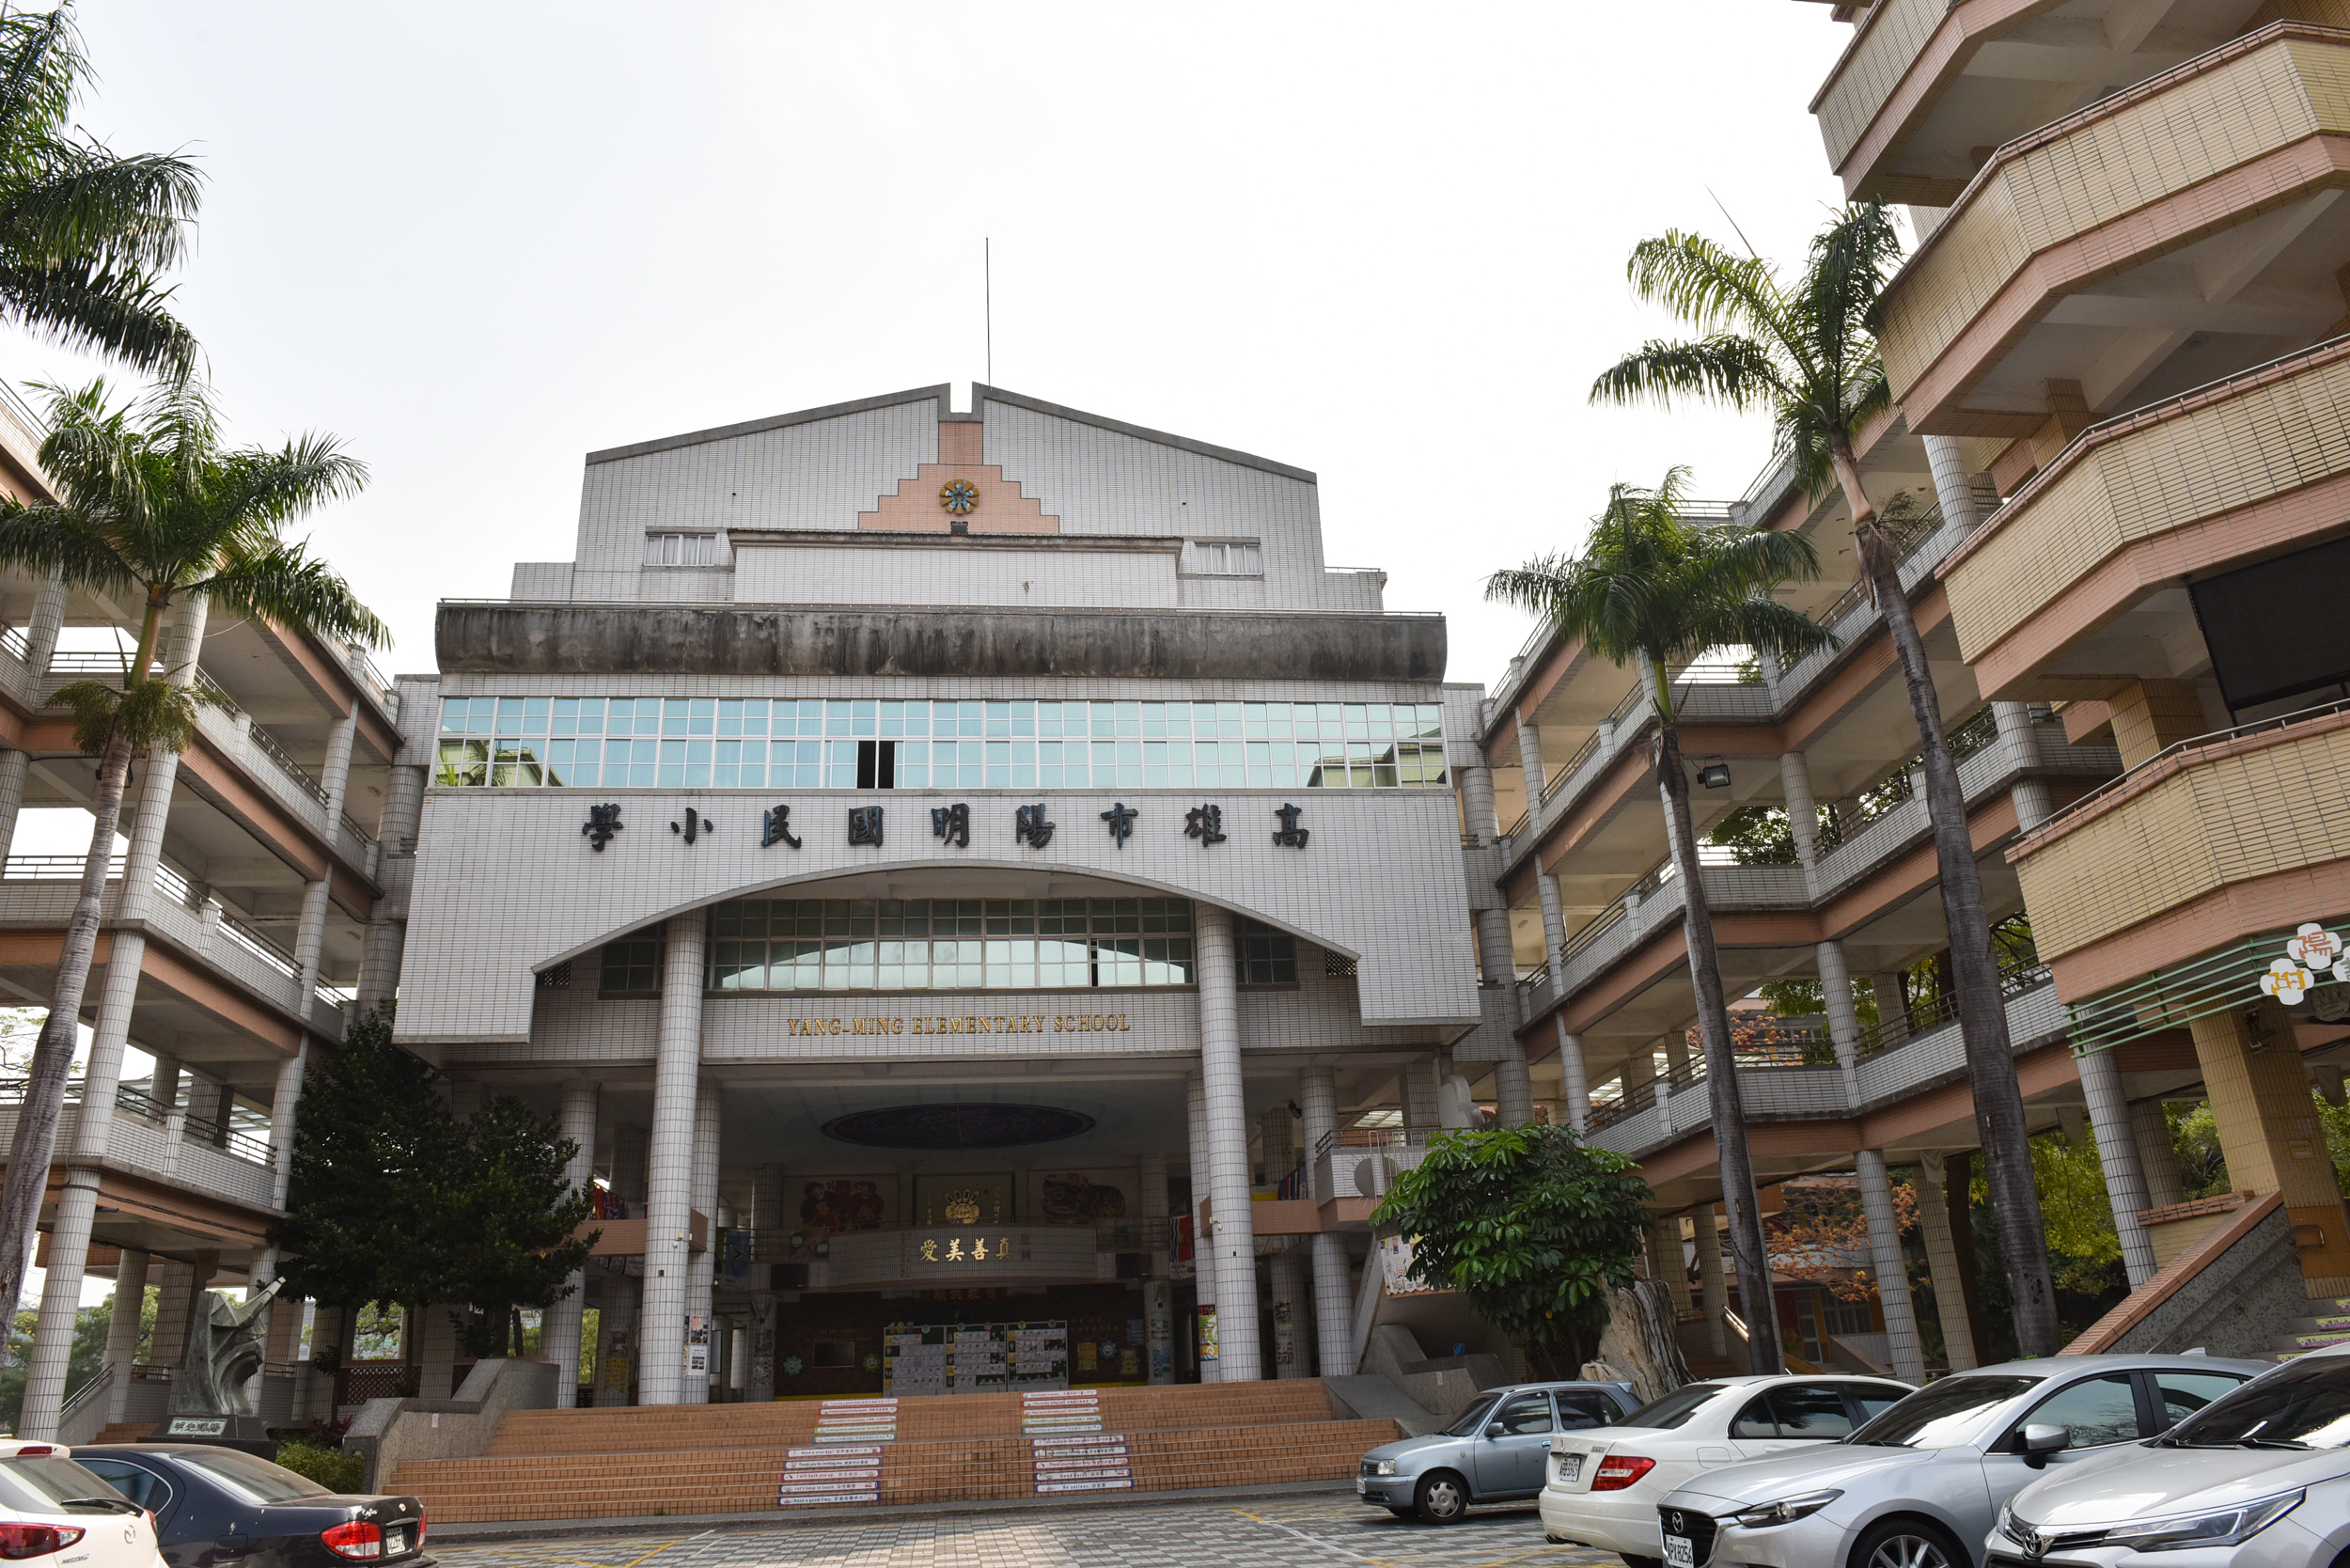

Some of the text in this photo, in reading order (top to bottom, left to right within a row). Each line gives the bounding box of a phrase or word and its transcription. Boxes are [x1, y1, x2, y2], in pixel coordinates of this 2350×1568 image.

[787, 1013, 1131, 1036] YANG-MING ELEMENTARY SCHOOL
